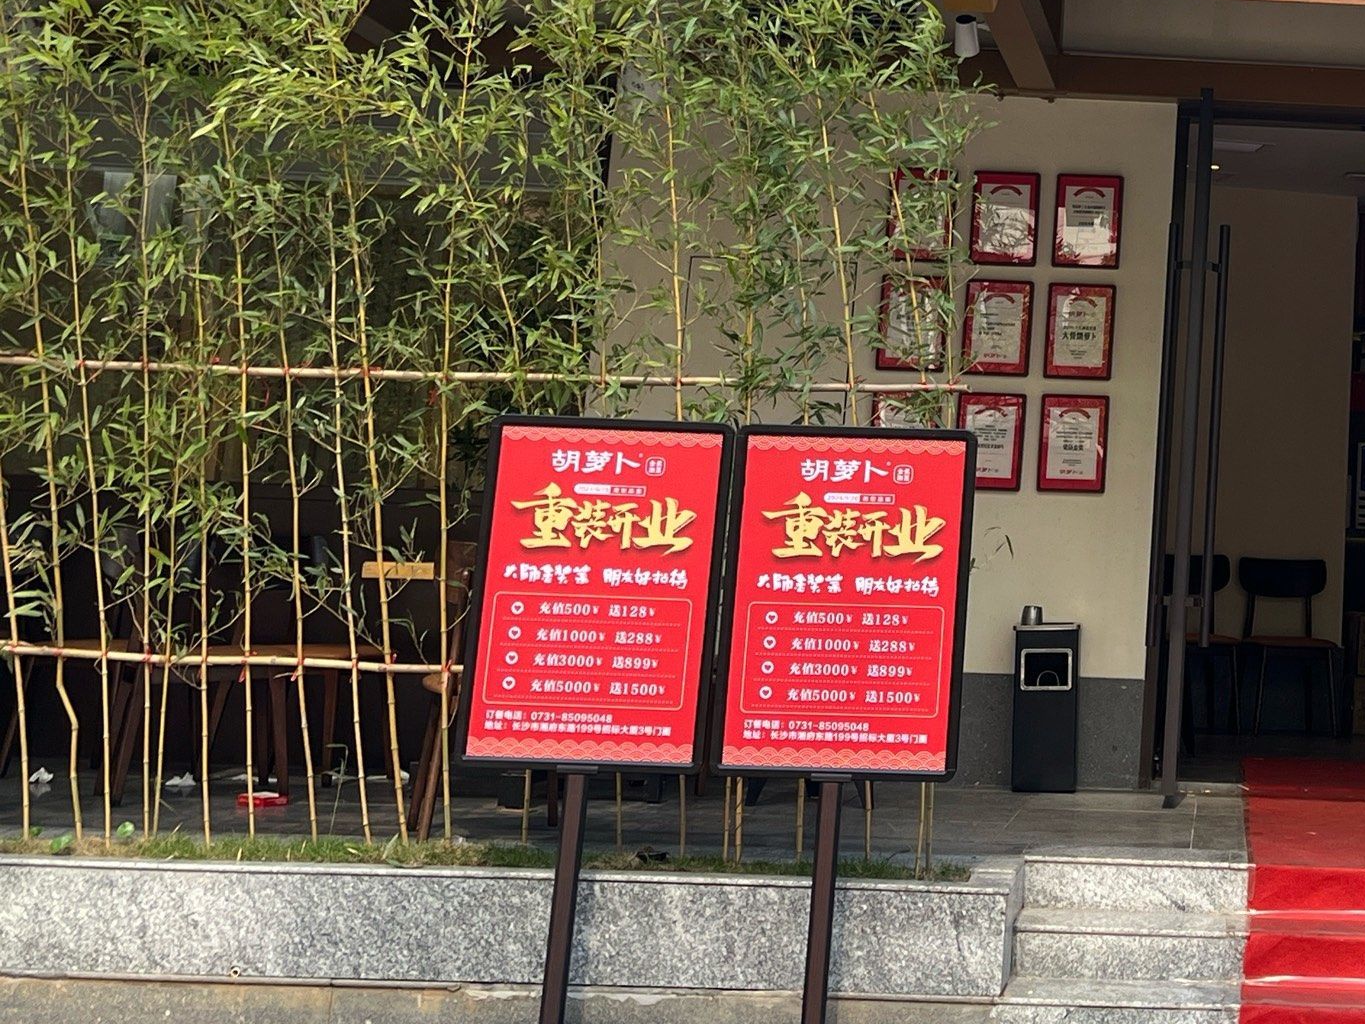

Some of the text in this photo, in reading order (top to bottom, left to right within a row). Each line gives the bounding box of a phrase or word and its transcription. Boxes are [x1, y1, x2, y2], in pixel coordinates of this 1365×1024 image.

[551, 449, 641, 475] 胡萝卜
[800, 459, 889, 484] 胡萝卜
[511, 482, 698, 556] 重装开业
[761, 491, 947, 565] 重装开业
